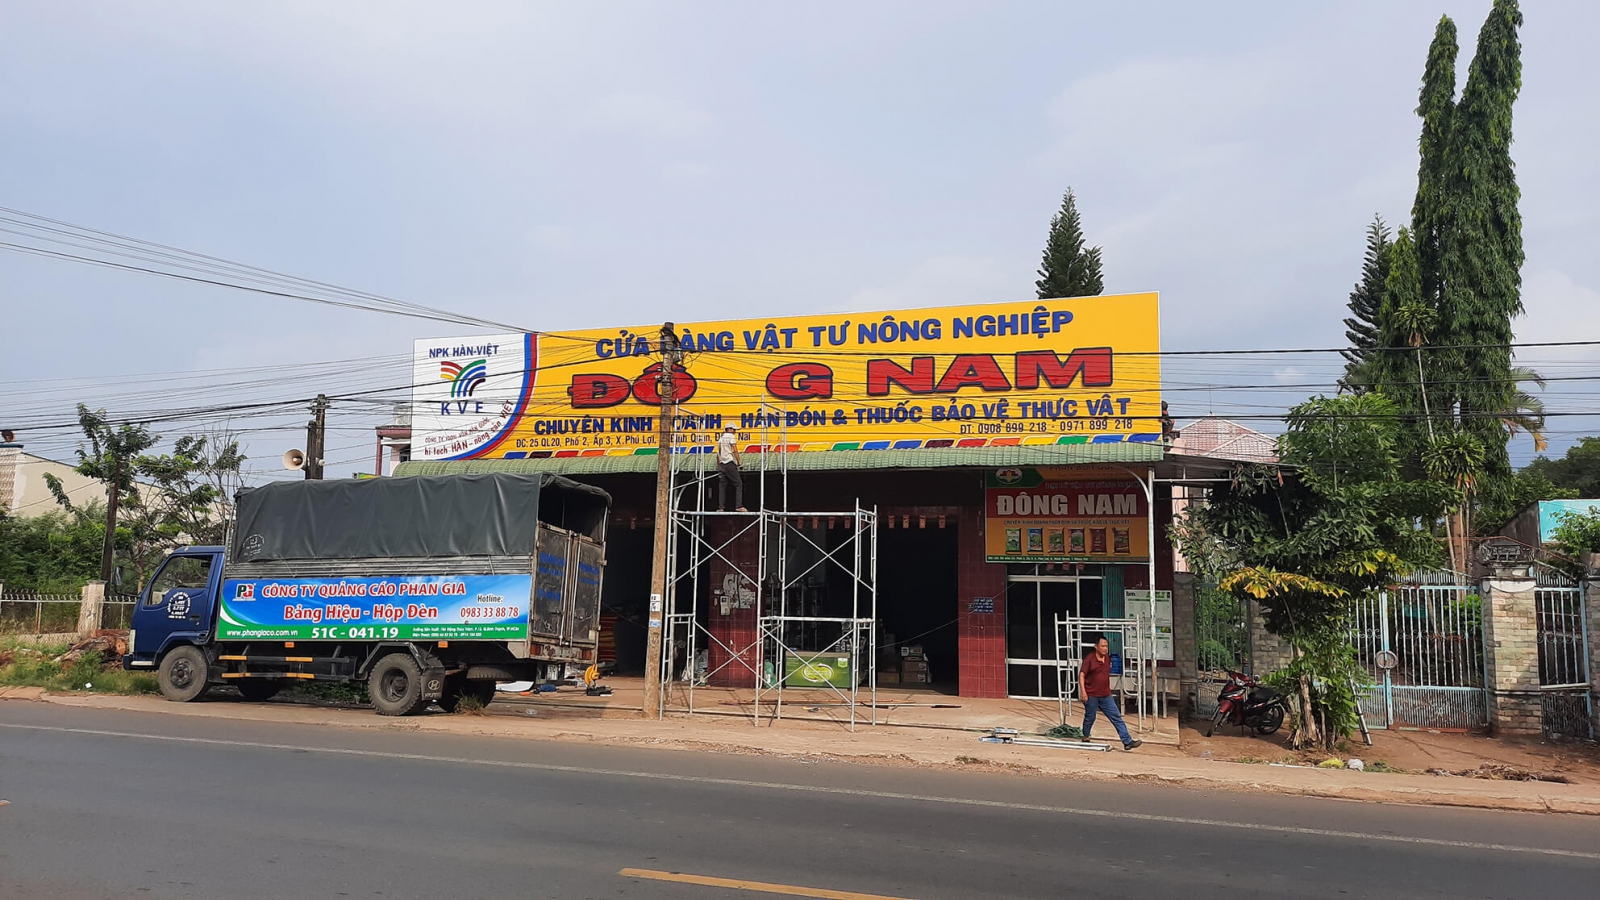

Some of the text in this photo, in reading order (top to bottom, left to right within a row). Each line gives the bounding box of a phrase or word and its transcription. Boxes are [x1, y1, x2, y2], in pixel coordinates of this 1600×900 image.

[596, 306, 1073, 357] CỬA ÀNG VẬT TƯ NÔNG NGHIỆP
[429, 343, 499, 358] NPK HÀN-VIỆT
[867, 347, 1113, 396] NAM
[534, 415, 605, 435] CHUYÊN
[611, 417, 652, 432] KINH
[786, 406, 827, 426] BÓN
[832, 409, 848, 425] &
[854, 400, 923, 424] THUỐC
[932, 398, 975, 422] BẢO
[984, 399, 1008, 423] VỆ
[1019, 397, 1077, 422] THỰC
[1086, 395, 1131, 421] VẬT
[978, 423, 1002, 434] 0908
[1005, 422, 1024, 433] 899
[1029, 422, 1047, 433] 218
[1060, 420, 1086, 432] 0971
[1089, 420, 1107, 431] 899
[1114, 419, 1133, 430] 218
[530, 438, 538, 447] 25
[565, 435, 580, 446] Phố
[593, 433, 603, 447] Ấp
[996, 491, 1137, 516] ĐÔNG NAM
[262, 581, 466, 598] CÔNG TY QUẢNG CÁO PHAN GIA
[477, 594, 503, 604] Hotline:
[284, 604, 322, 623] Bảng
[325, 604, 361, 624] Hiệu
[373, 603, 403, 623] Hộp
[407, 604, 438, 619] Đèn
[460, 607, 519, 618] 0983 33 88 78
[226, 629, 299, 638] www.phangiaco.com.vn
[311, 627, 338, 638] 51C
[349, 627, 399, 639] 041.19
